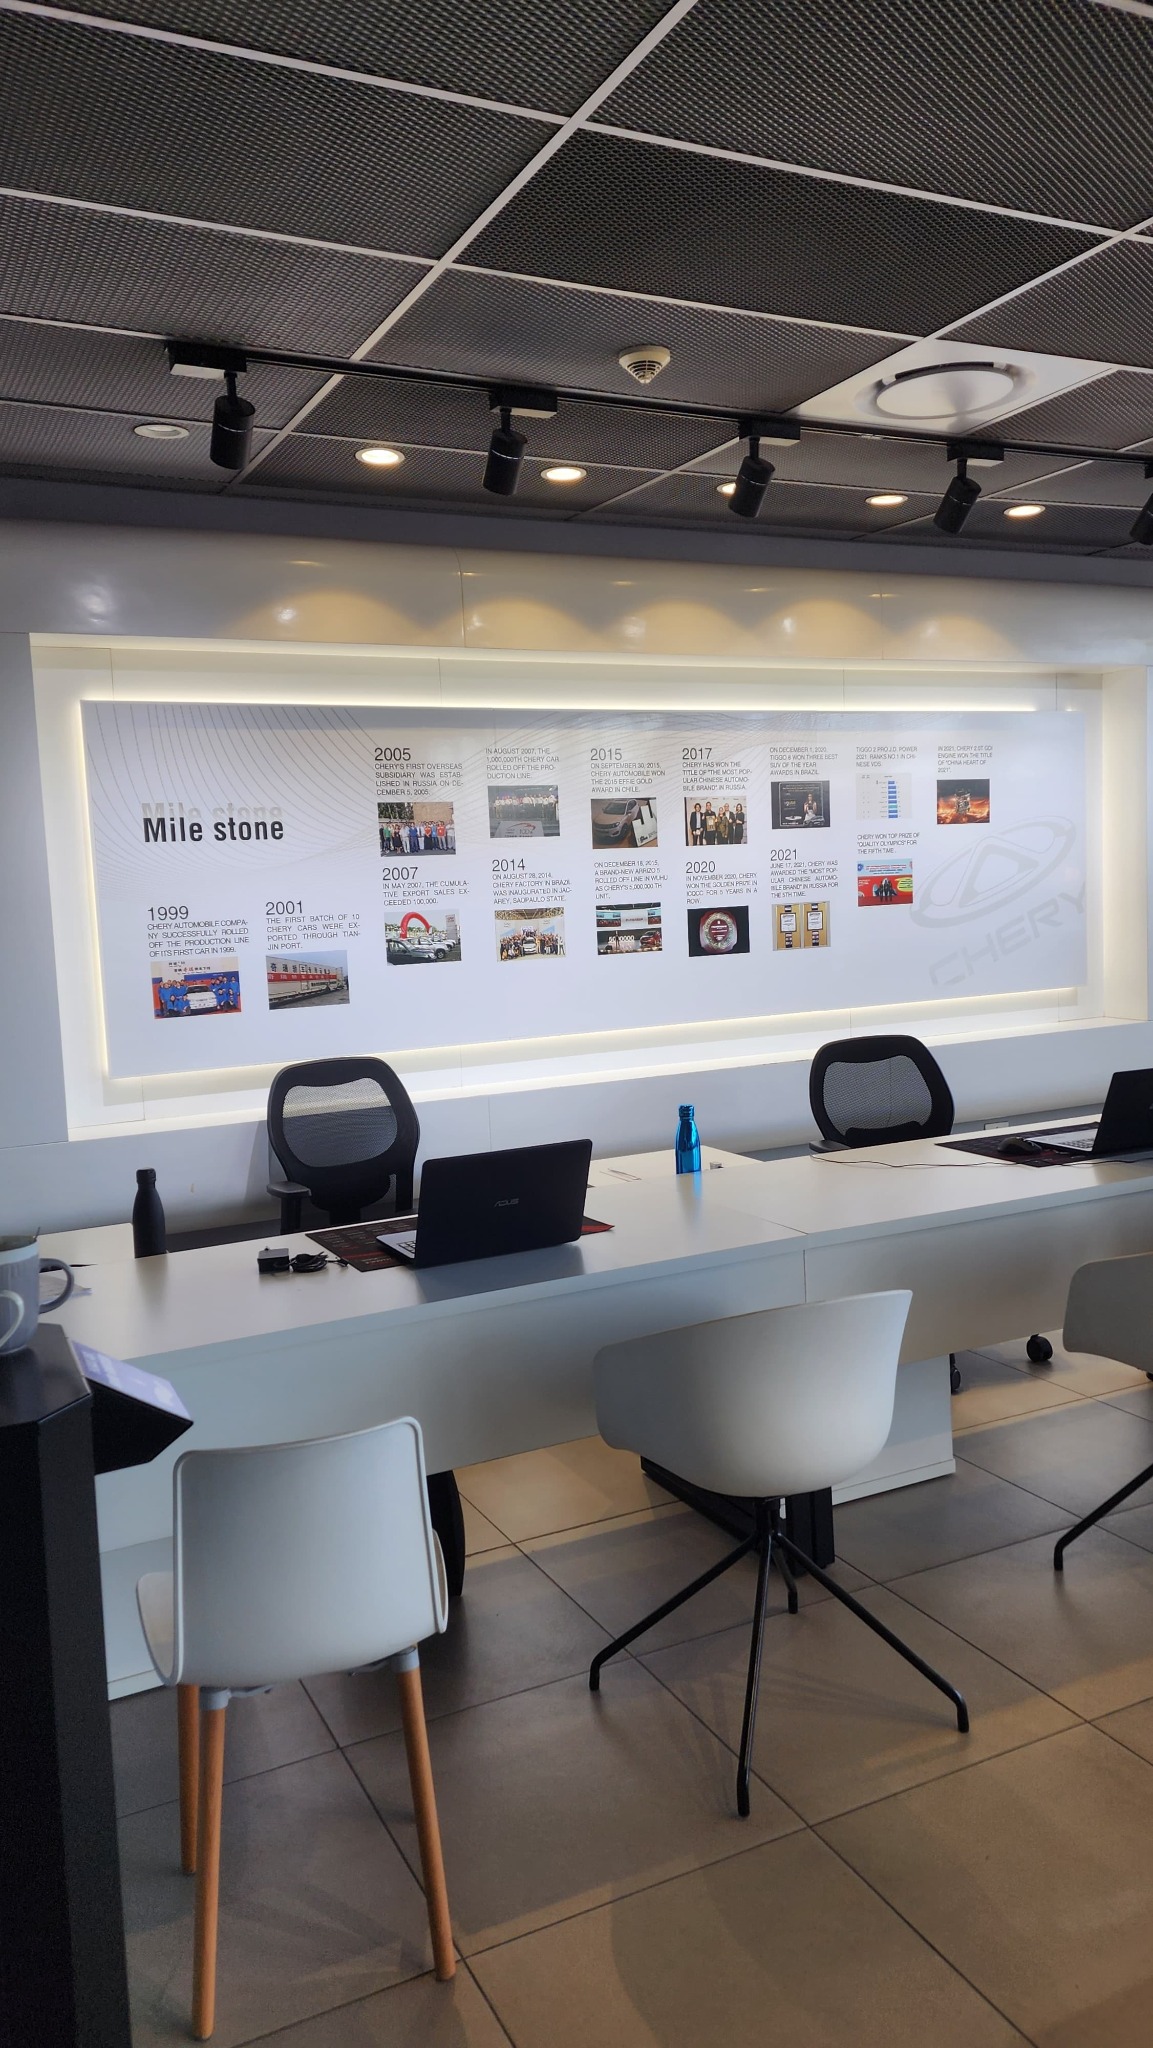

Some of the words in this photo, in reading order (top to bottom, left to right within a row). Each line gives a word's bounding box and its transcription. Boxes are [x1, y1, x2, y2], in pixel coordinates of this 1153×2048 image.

[375, 748, 411, 761] 2005
[591, 748, 622, 760] 2015
[682, 748, 712, 759] 2017
[143, 817, 203, 842] Mile
[213, 817, 284, 841] stone
[771, 849, 797, 861] 2021
[492, 858, 525, 871] 2014
[686, 861, 715, 873] 2020
[383, 867, 418, 880] 2007
[148, 906, 189, 920] 1999
[266, 901, 302, 915] 2001
[174, 921, 220, 929] AUTOMOBILE
[162, 930, 217, 938] SUCCESSFULLY
[929, 882, 1085, 986] CHERY
[185, 938, 231, 946] PRODUCTION
